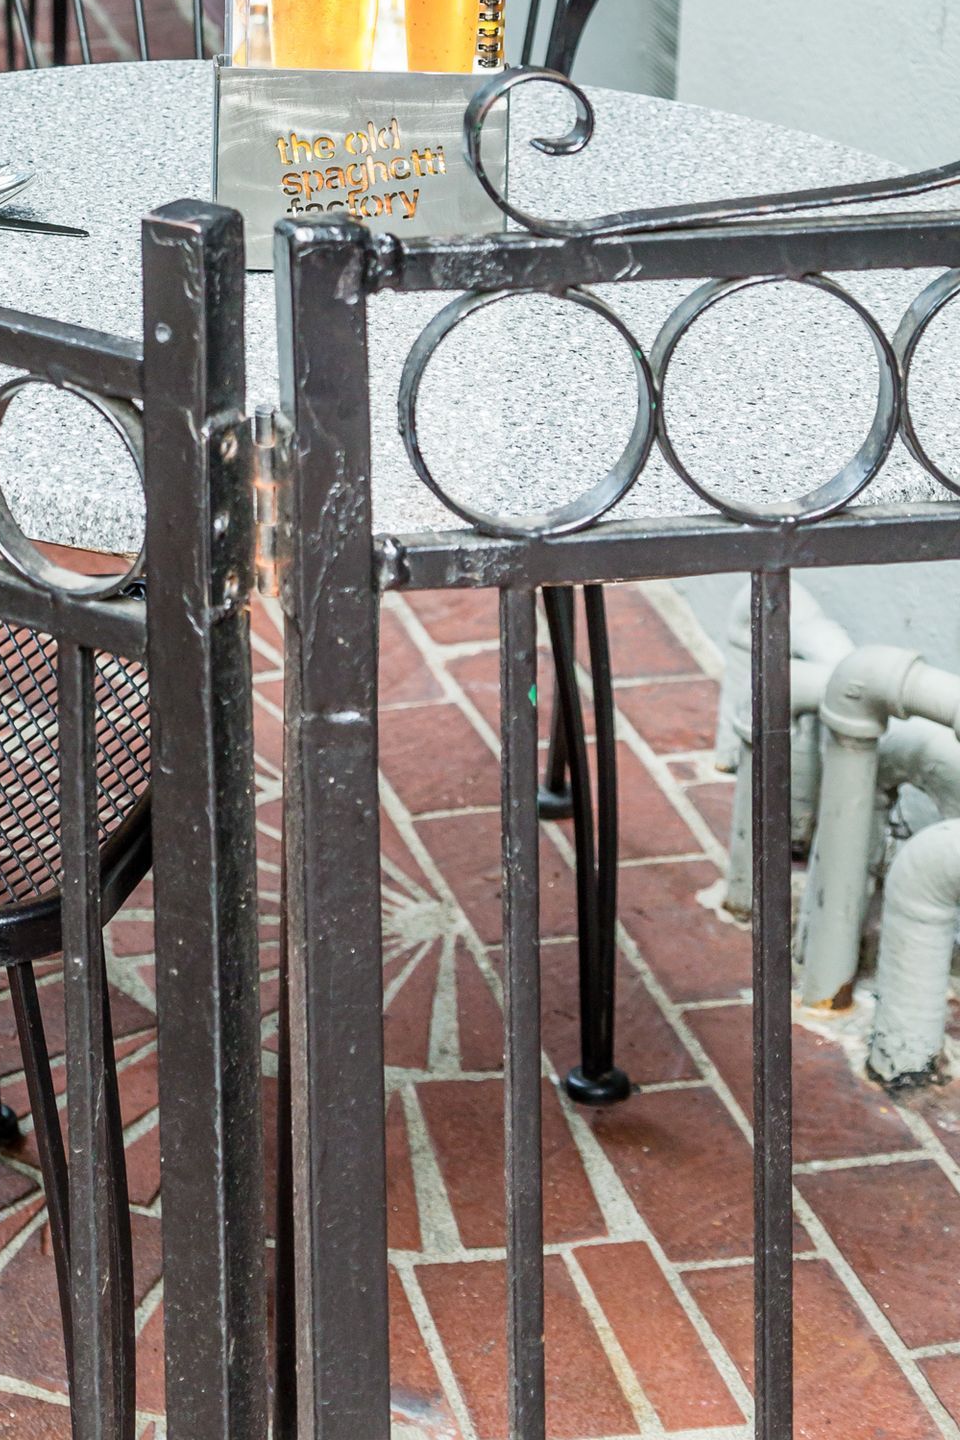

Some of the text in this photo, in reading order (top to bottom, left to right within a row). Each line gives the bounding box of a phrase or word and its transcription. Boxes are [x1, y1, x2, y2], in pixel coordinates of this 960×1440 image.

[276, 117, 401, 165] the old
[282, 146, 447, 201] spaghetti
